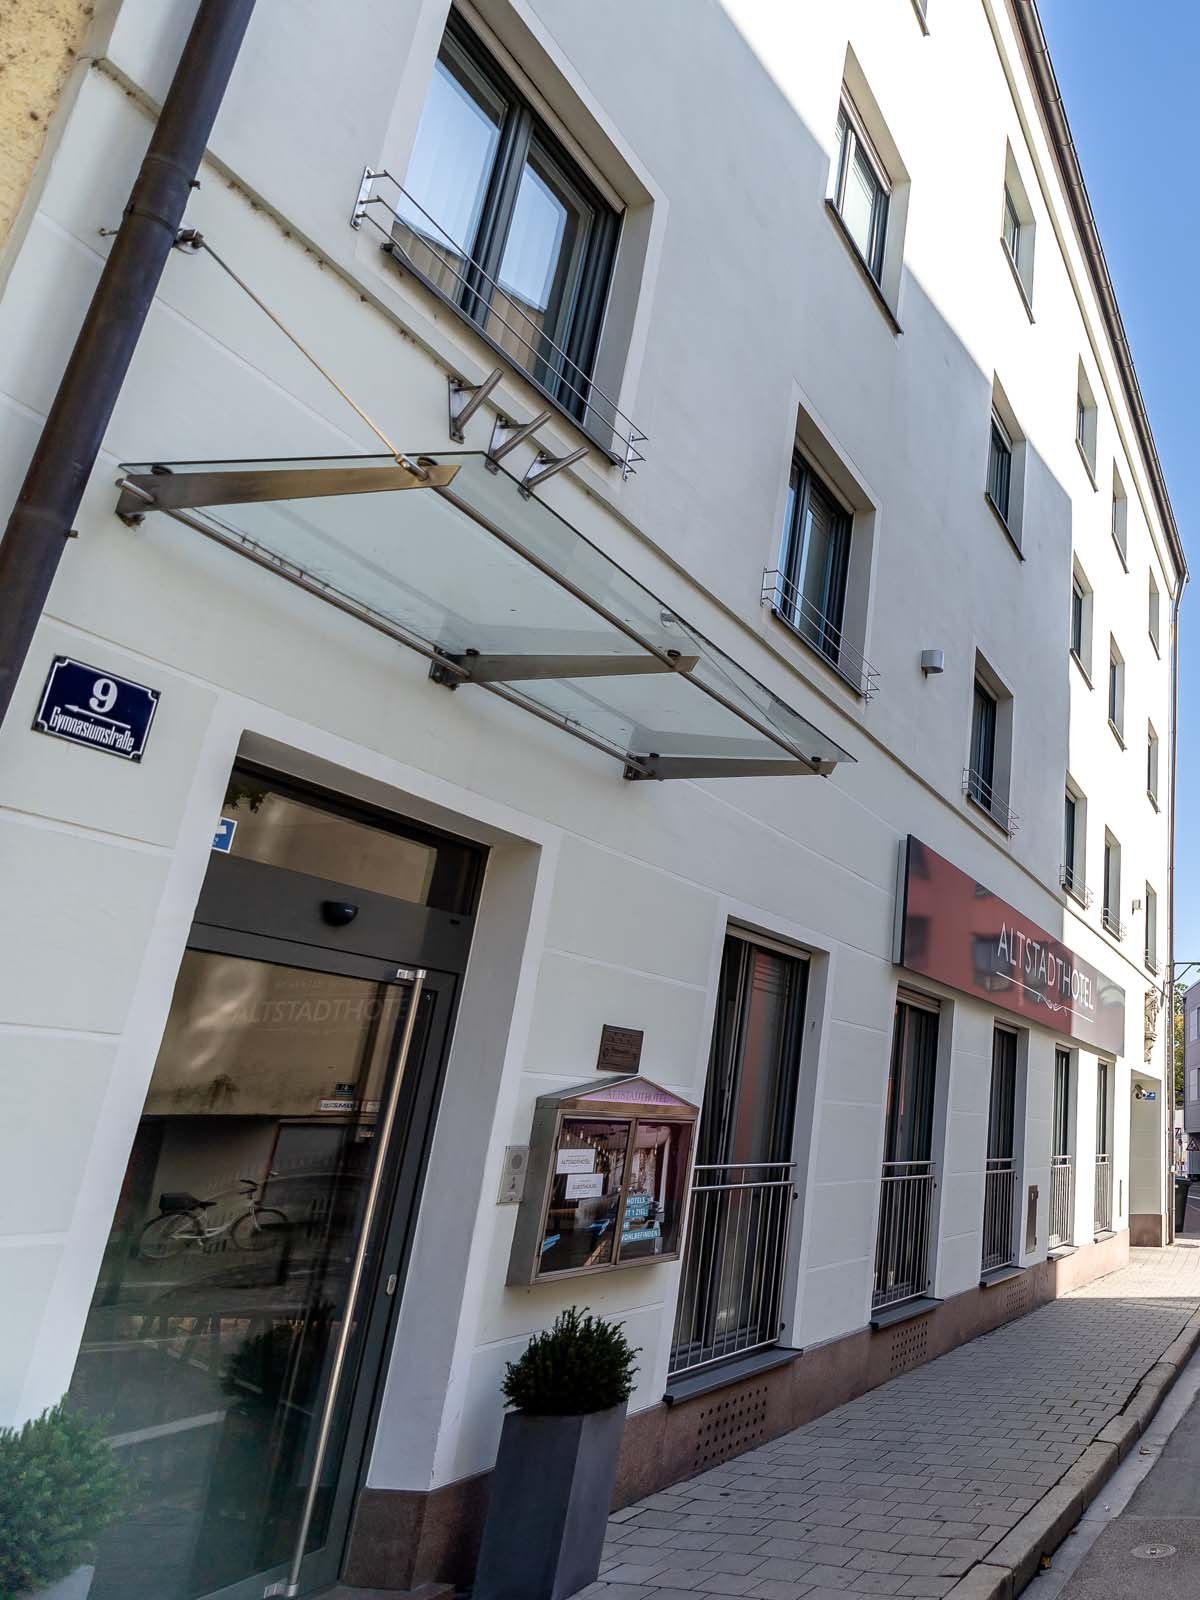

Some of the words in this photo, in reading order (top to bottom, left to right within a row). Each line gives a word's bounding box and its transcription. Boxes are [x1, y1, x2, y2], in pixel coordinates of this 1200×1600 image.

[89, 678, 118, 713] 9
[49, 705, 135, 752] Gymnasiumstraße
[997, 921, 1094, 1010] ALTSTADTHOTEL
